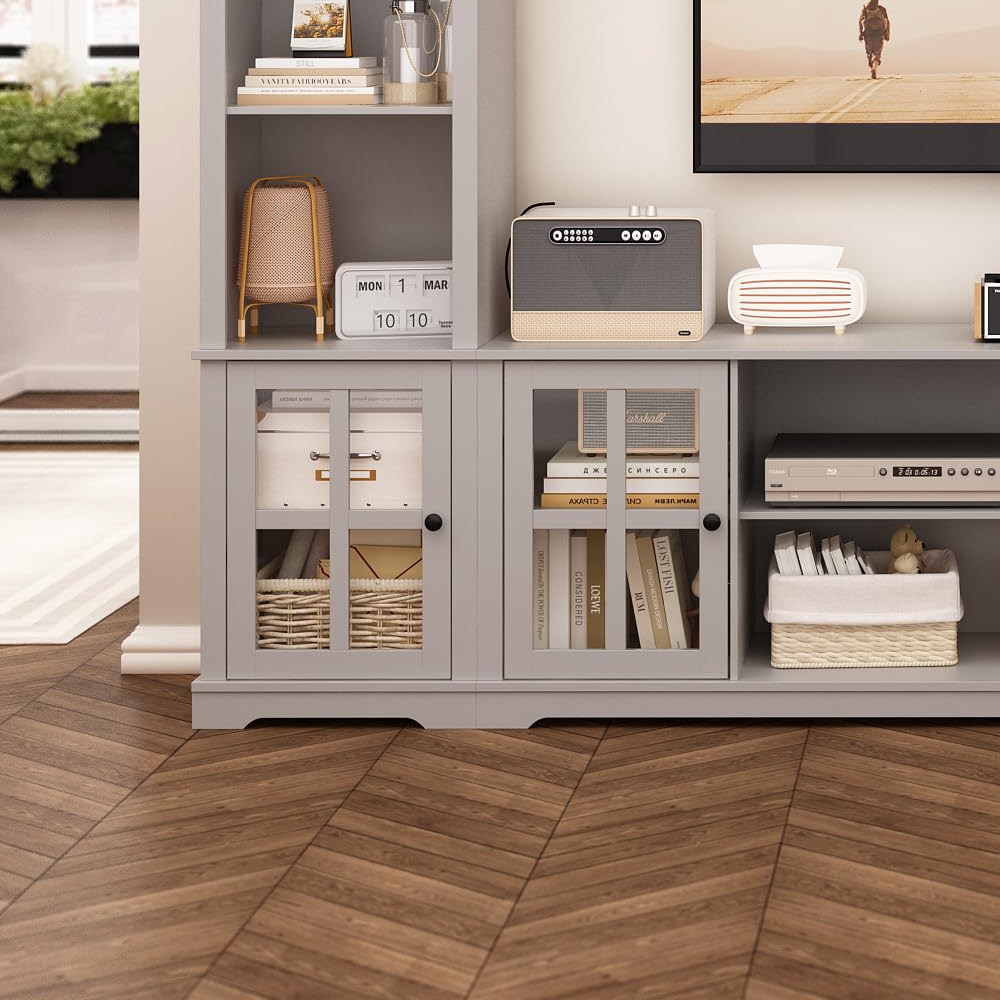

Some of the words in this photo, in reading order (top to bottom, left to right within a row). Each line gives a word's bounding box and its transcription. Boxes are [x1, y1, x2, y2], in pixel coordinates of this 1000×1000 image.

[358, 281, 382, 292] MON
[398, 278, 405, 293] 1
[424, 280, 448, 290] MAR
[376, 313, 395, 328] 10
[409, 313, 428, 328] 10
[626, 410, 666, 423] arshall
[656, 540, 671, 568] LOST
[662, 570, 675, 594] FISH
[590, 585, 601, 614] LOEWE
